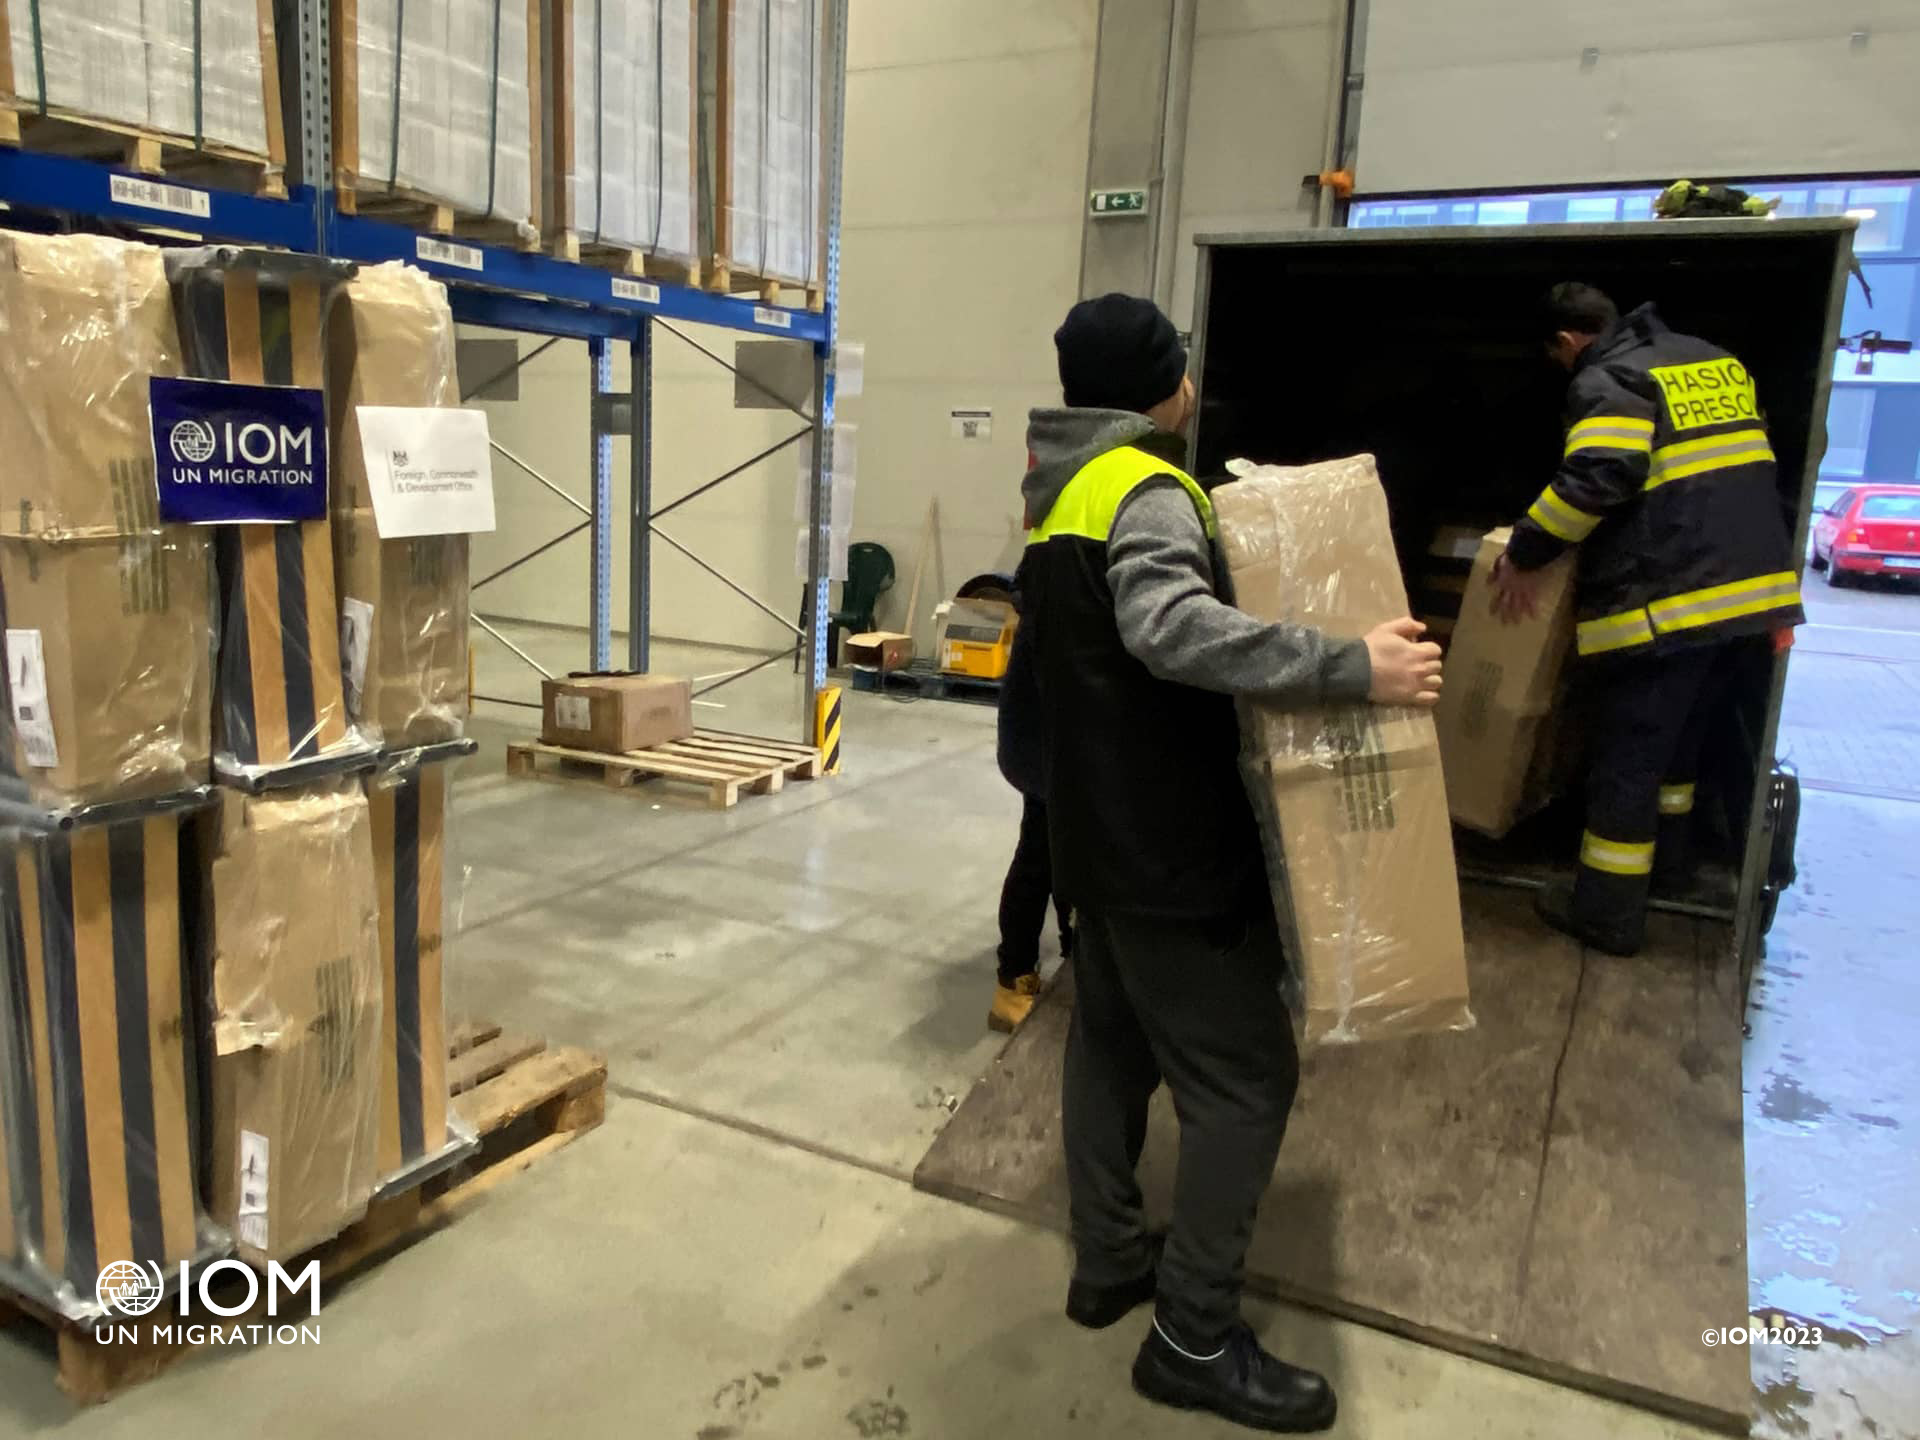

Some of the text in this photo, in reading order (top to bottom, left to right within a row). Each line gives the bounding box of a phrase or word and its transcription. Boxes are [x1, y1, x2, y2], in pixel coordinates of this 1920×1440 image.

[225, 422, 312, 465] IOM
[172, 467, 313, 485] UN MIGRATION
